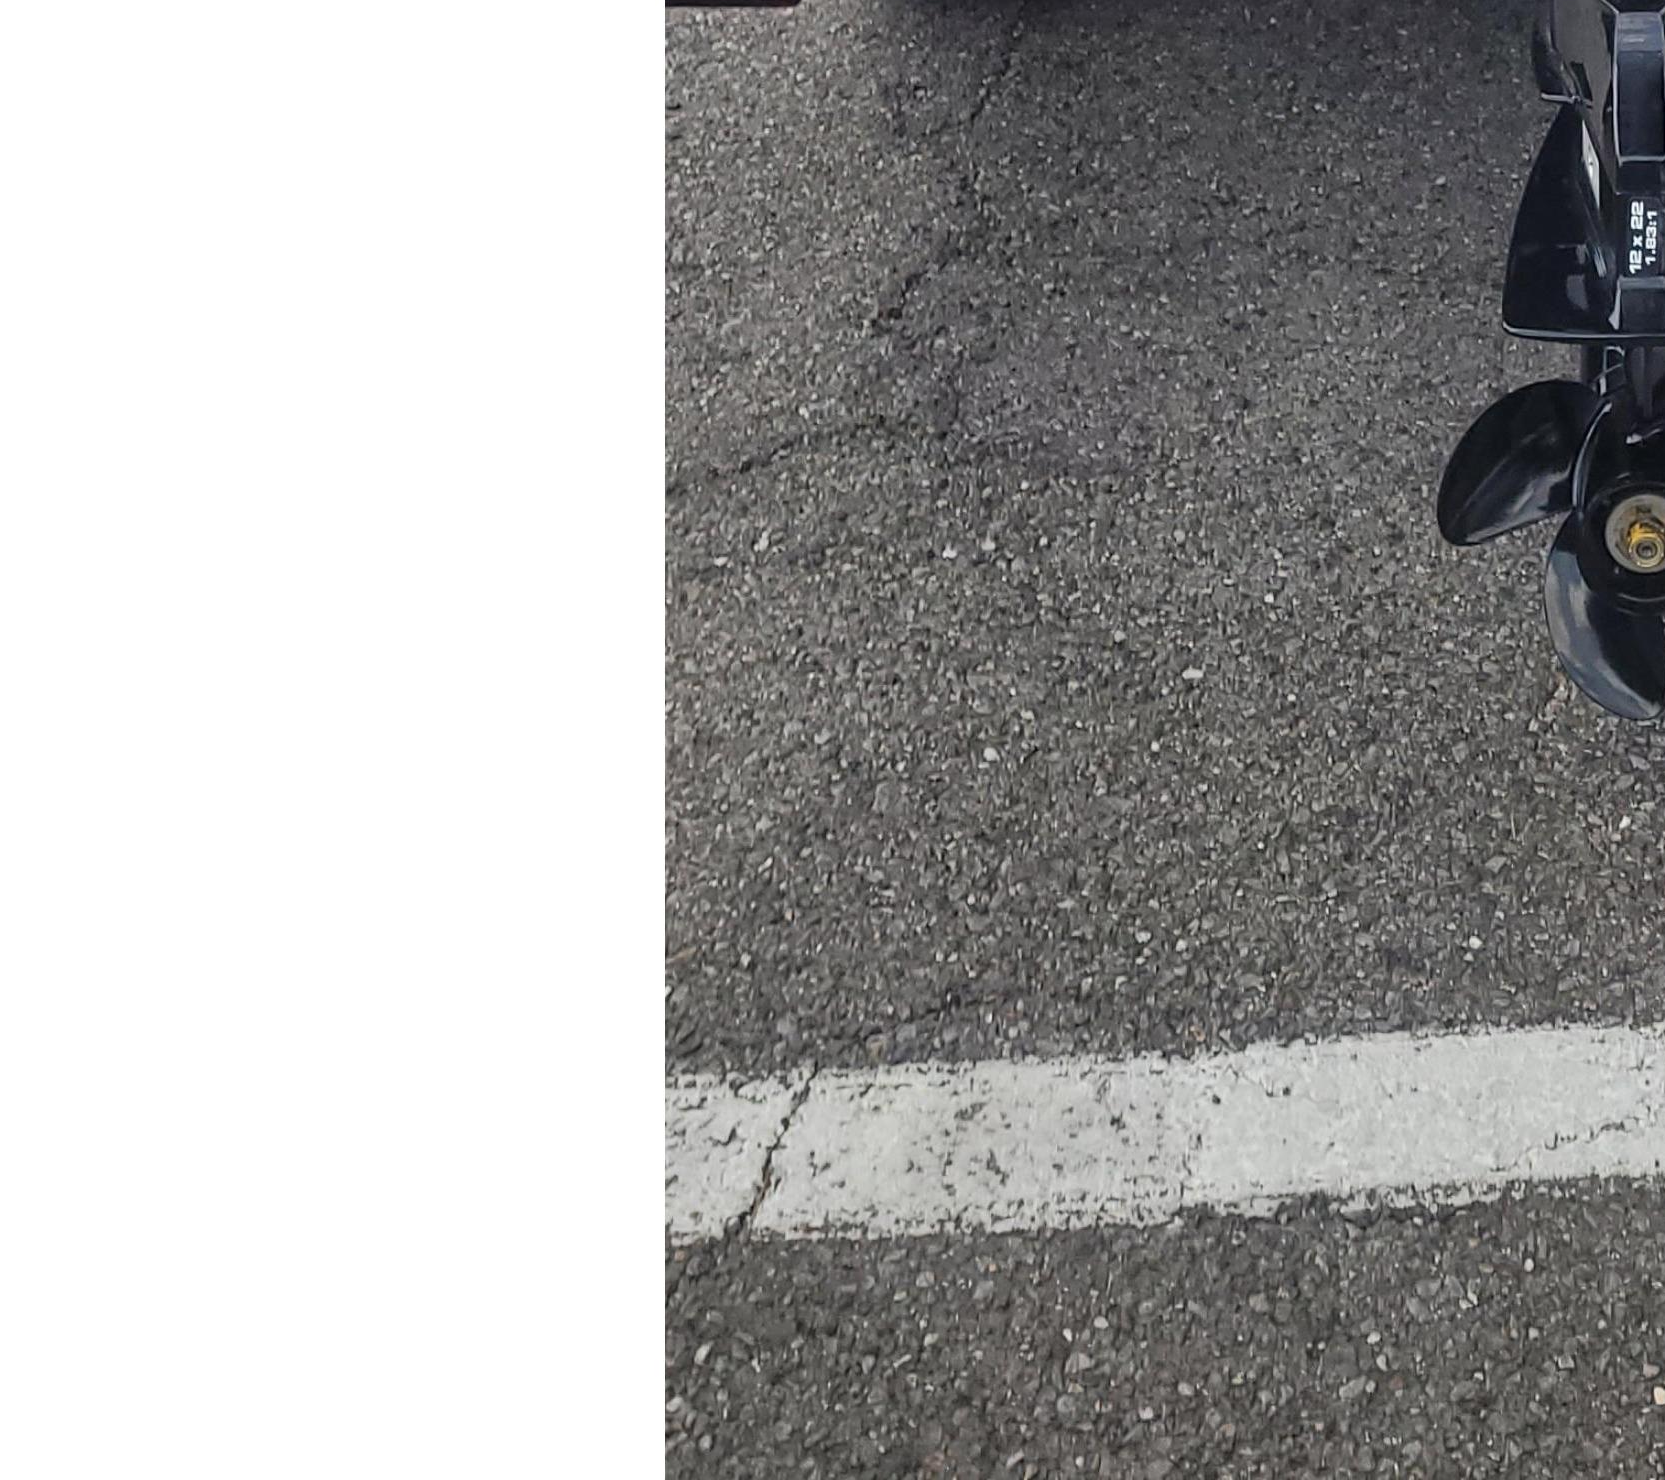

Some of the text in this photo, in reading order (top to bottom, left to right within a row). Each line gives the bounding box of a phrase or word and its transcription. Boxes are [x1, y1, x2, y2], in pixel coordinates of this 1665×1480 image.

[1630, 200, 1644, 230] 22
[1644, 210, 1658, 266] 1.83:1
[1629, 249, 1643, 275] 12
